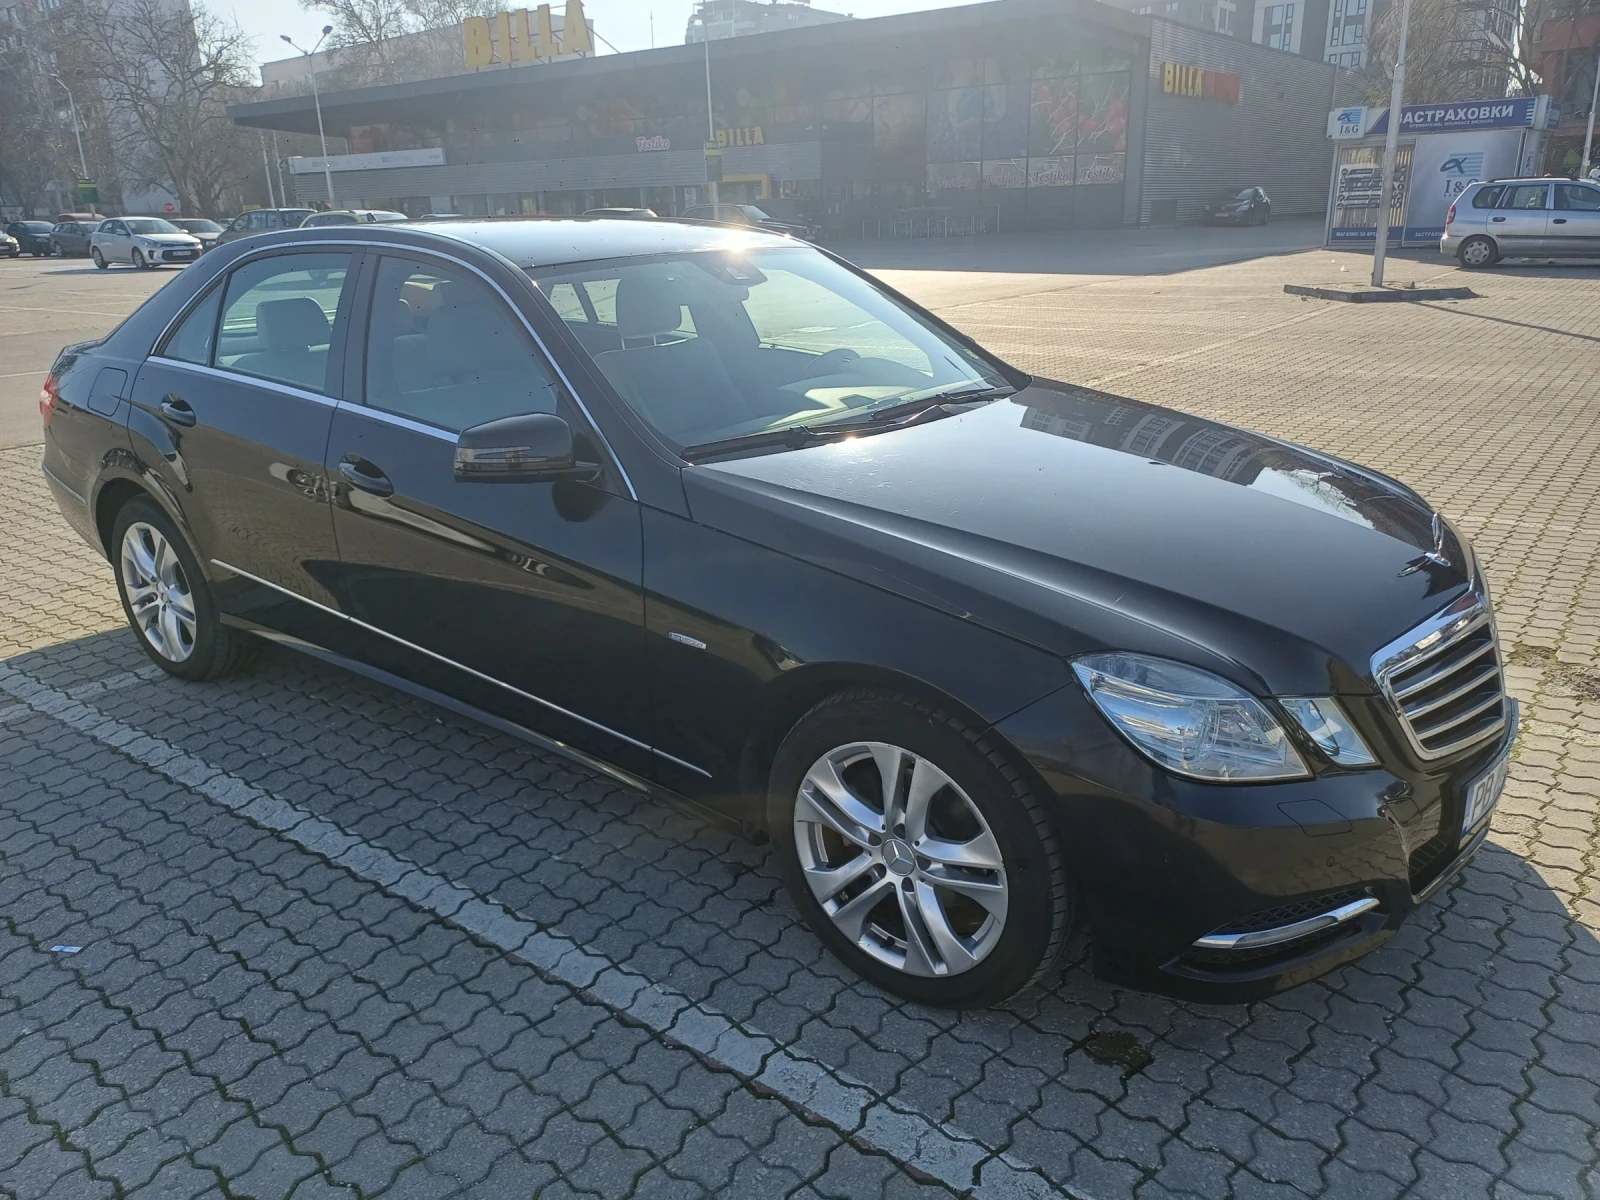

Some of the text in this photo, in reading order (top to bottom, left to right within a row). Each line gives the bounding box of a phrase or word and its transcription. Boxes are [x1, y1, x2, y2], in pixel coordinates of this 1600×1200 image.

[463, 0, 593, 68] BILLA
[1164, 61, 1204, 98] BILLA
[636, 136, 670, 151] Festiko
[716, 126, 764, 148] BILLA
[1033, 169, 1069, 183] Festiko
[1081, 167, 1120, 182] Festiko
